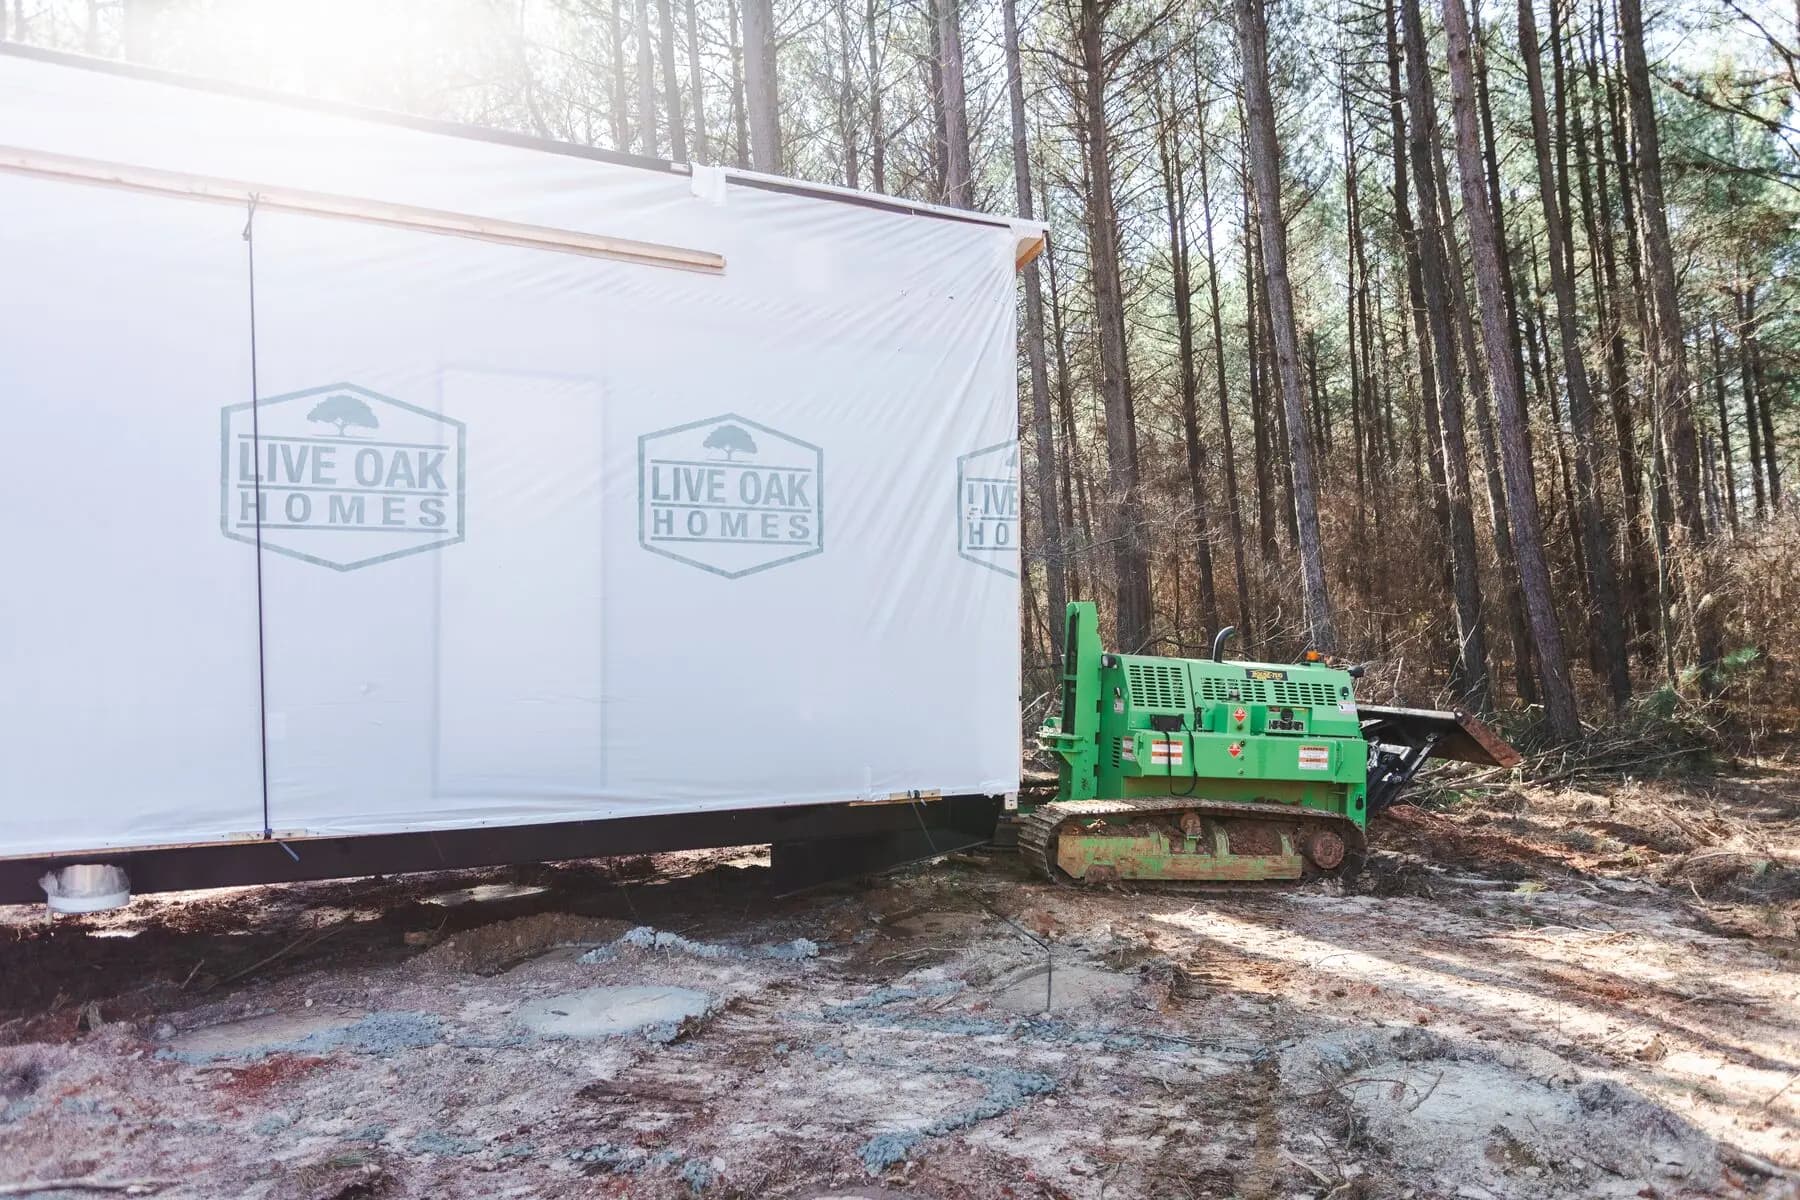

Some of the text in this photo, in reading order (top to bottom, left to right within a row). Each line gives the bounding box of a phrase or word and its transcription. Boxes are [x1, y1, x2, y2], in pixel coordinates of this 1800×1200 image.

[239, 442, 447, 490] LIVE OAK
[652, 466, 810, 508] LIVE OAK
[240, 491, 446, 527] HOMES
[653, 509, 810, 540] HOMES
